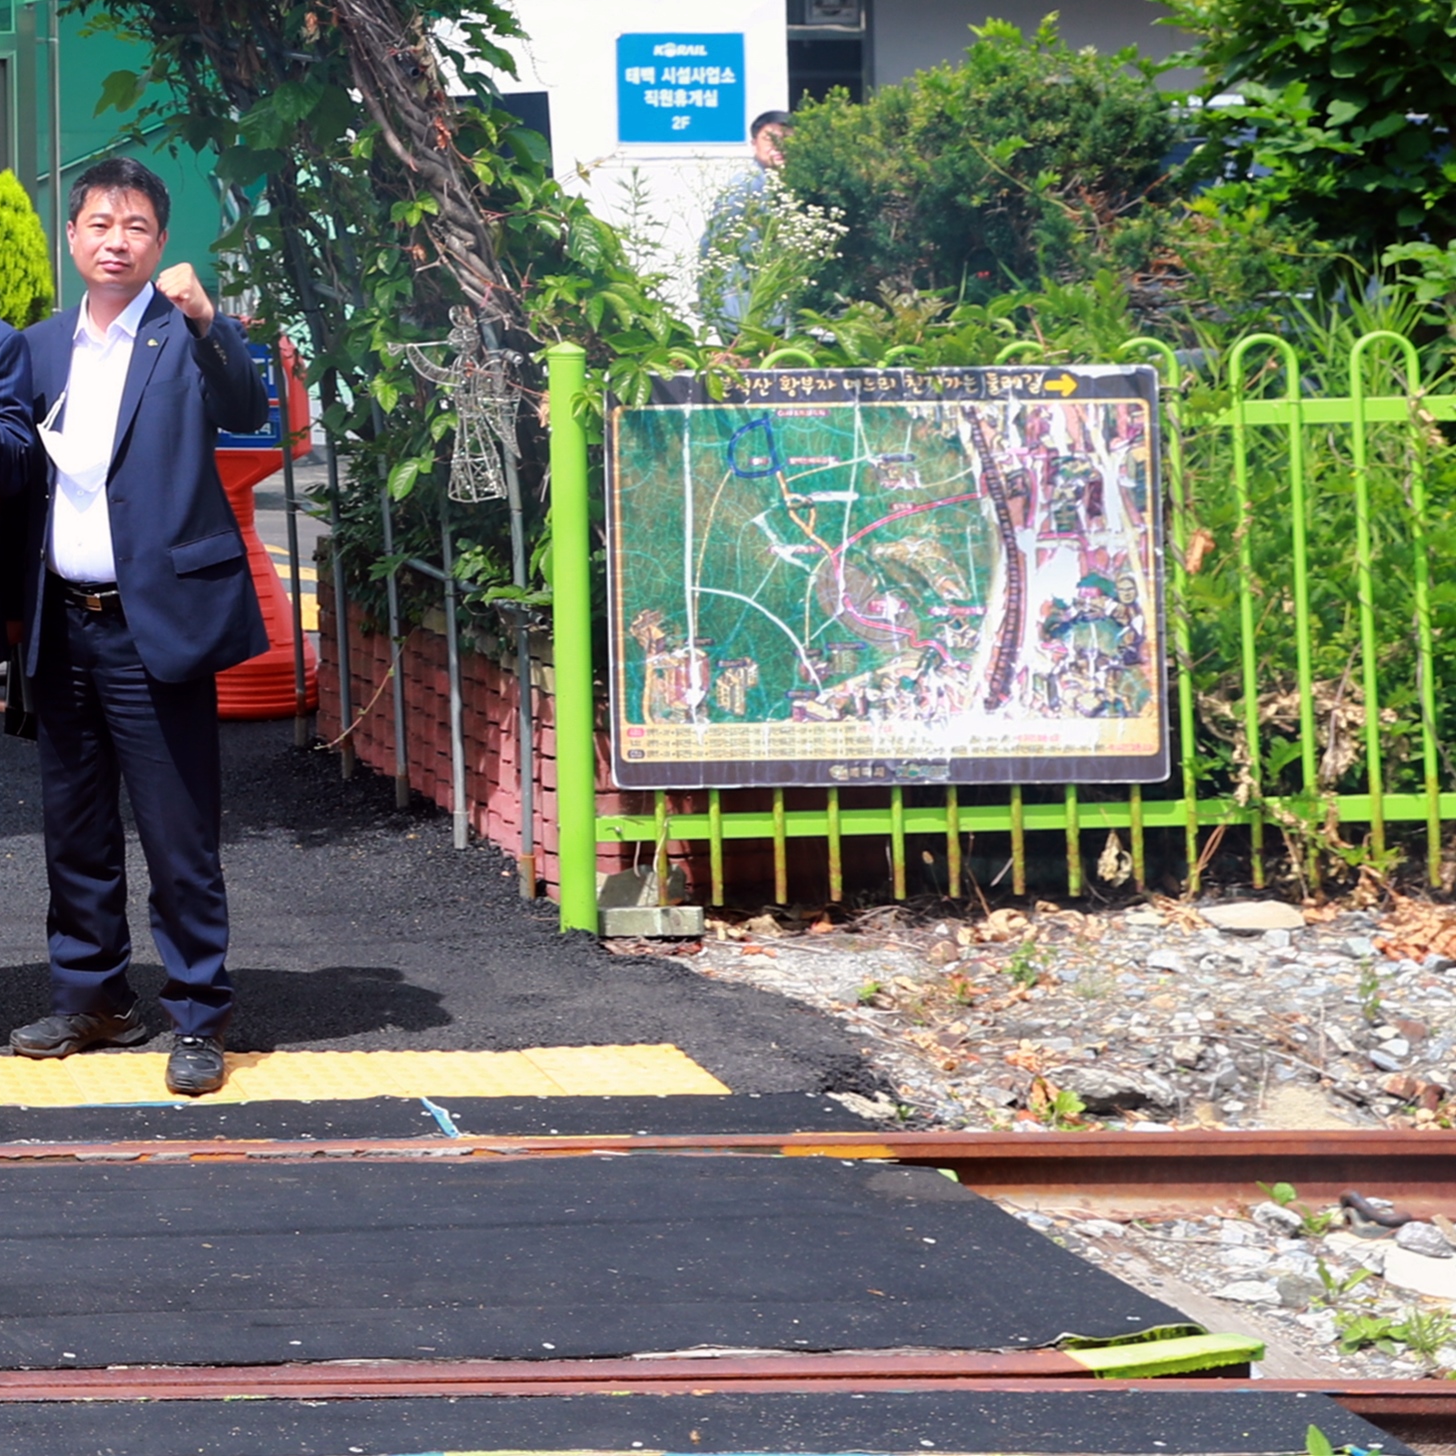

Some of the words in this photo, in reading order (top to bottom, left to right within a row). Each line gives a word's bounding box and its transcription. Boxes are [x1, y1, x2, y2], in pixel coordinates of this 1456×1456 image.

[653, 42, 708, 58] KORAIL
[624, 67, 656, 85] 태백
[661, 66, 736, 85] 시설사업소
[643, 89, 719, 108] 직원휴게실
[671, 115, 691, 131] 2F
